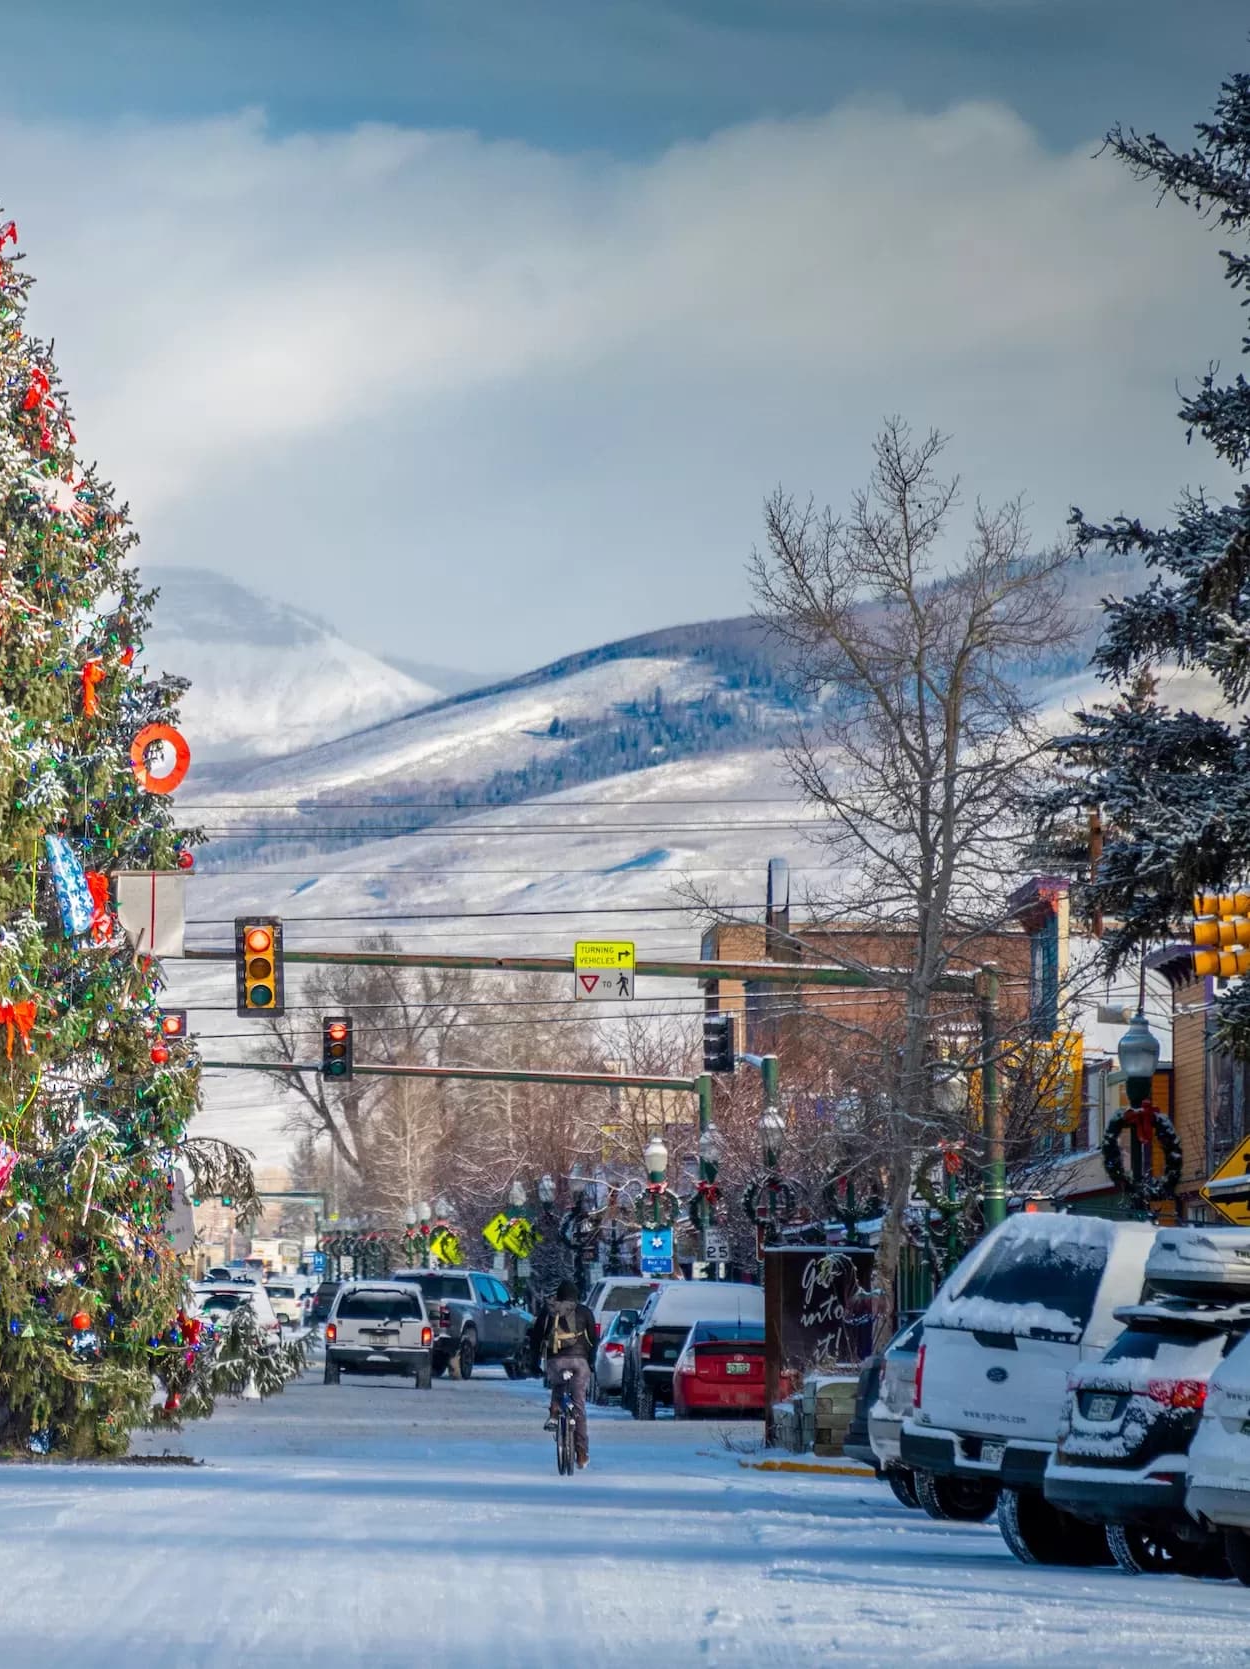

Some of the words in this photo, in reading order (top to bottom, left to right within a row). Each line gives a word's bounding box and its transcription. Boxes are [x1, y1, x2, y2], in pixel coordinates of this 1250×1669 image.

[581, 946, 615, 954] TURNING
[579, 957, 615, 965] VEHICLES
[602, 980, 613, 989] TO
[706, 1246, 728, 1259] 25
[315, 1255, 323, 1265] H
[801, 1258, 843, 1305] Get
[800, 1294, 845, 1328] into
[812, 1326, 843, 1361] it!
